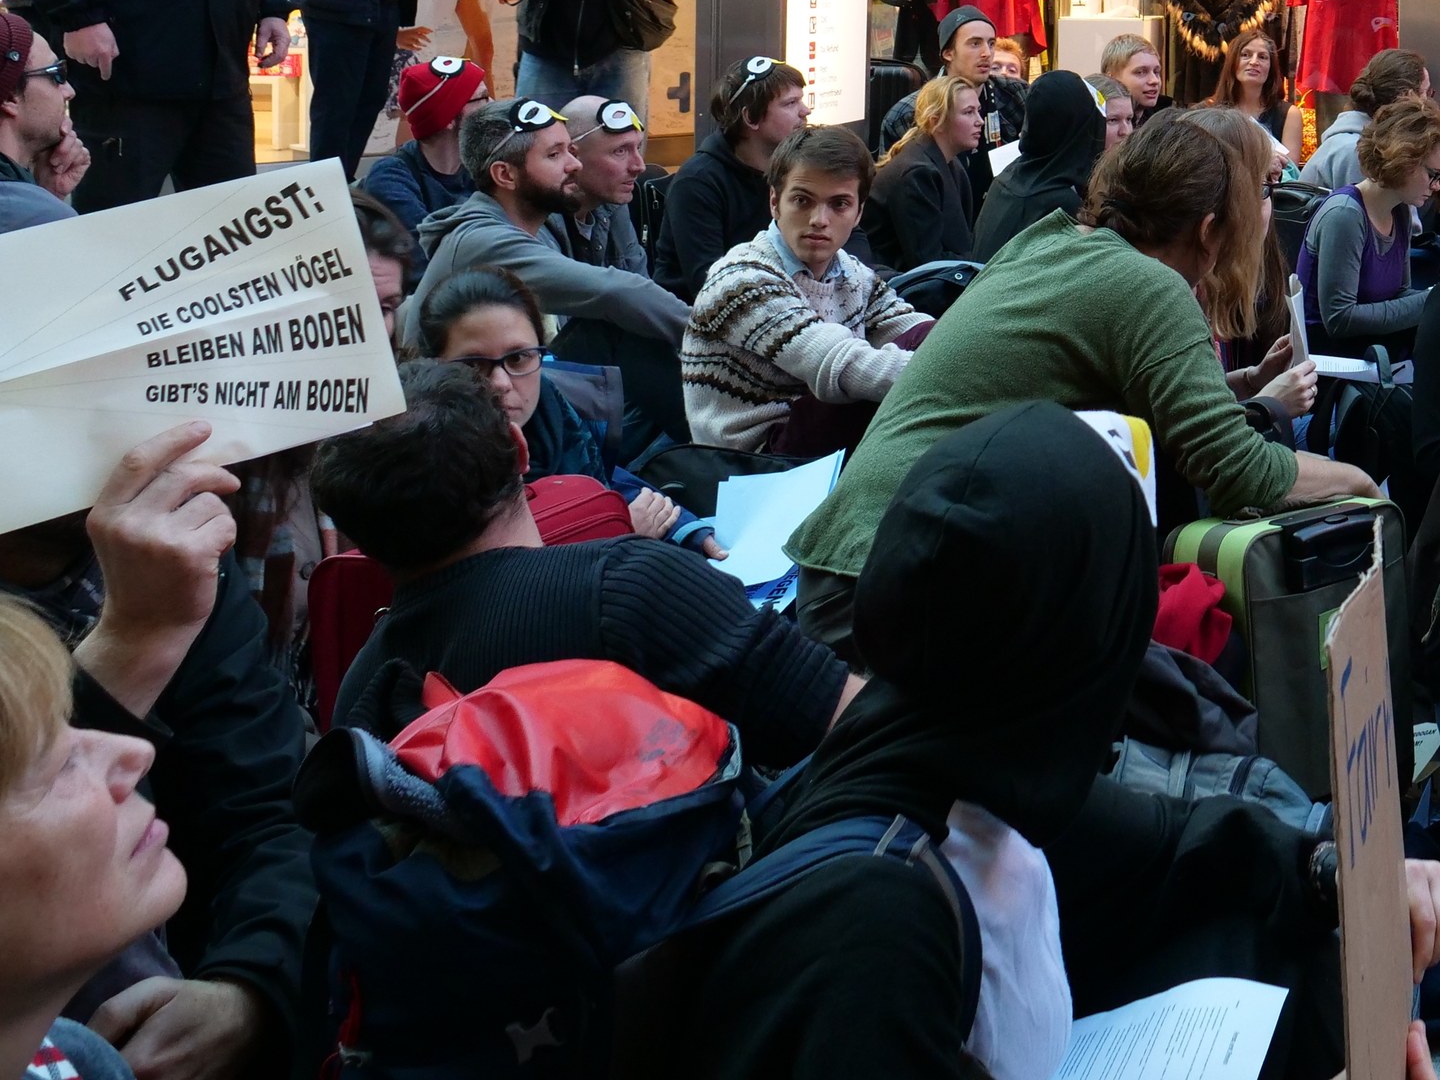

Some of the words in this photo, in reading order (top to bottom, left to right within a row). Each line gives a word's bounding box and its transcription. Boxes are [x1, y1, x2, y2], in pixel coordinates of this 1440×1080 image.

[118, 182, 324, 302] FLUGANGST:
[137, 313, 173, 336] DIE
[176, 272, 282, 324] COOLSTEN
[281, 248, 353, 292] VÖGEL
[146, 331, 245, 368] BLEIBEN
[252, 323, 284, 356] AM
[288, 303, 366, 352] BODEN
[215, 381, 269, 408] NICHT
[273, 380, 301, 410] AM
[306, 378, 369, 413] BODEN
